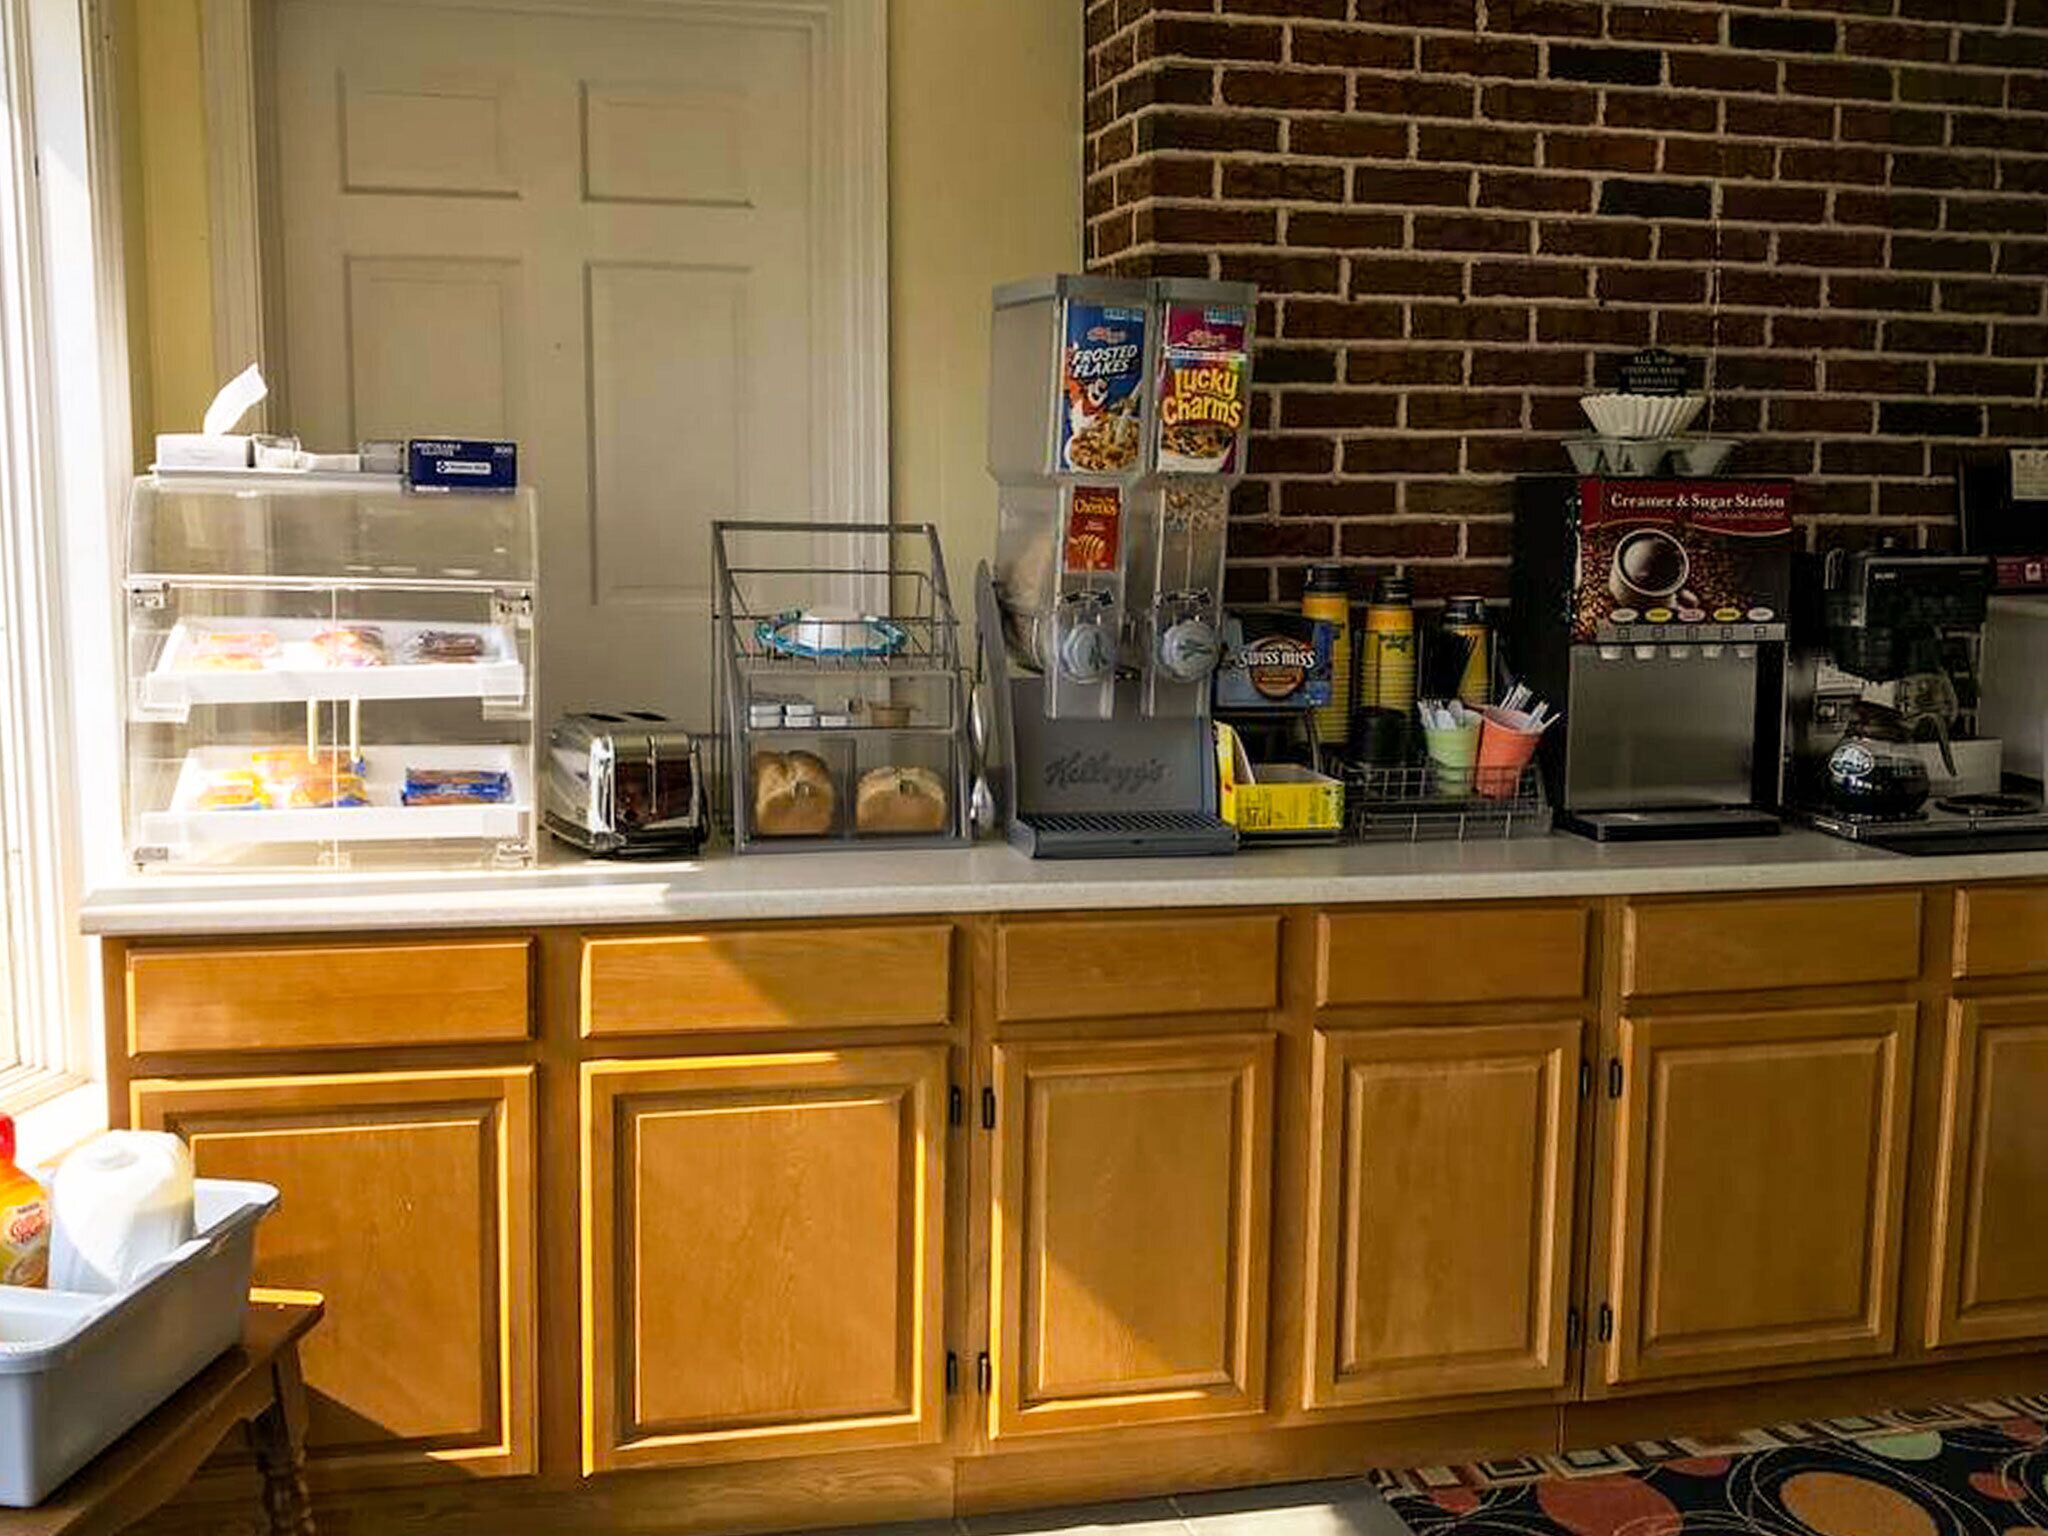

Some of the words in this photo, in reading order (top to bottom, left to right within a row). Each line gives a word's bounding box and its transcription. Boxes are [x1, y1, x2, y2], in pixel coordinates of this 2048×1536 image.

[1072, 344, 1138, 366] FROSTED
[1074, 360, 1130, 379] FLAKES
[1175, 368, 1239, 400] Lucky
[1163, 397, 1243, 428] Charms
[1610, 493, 1673, 508] Creamer
[1676, 493, 1690, 508] &
[1691, 493, 1733, 511] Sugar
[1735, 492, 1786, 508] Station
